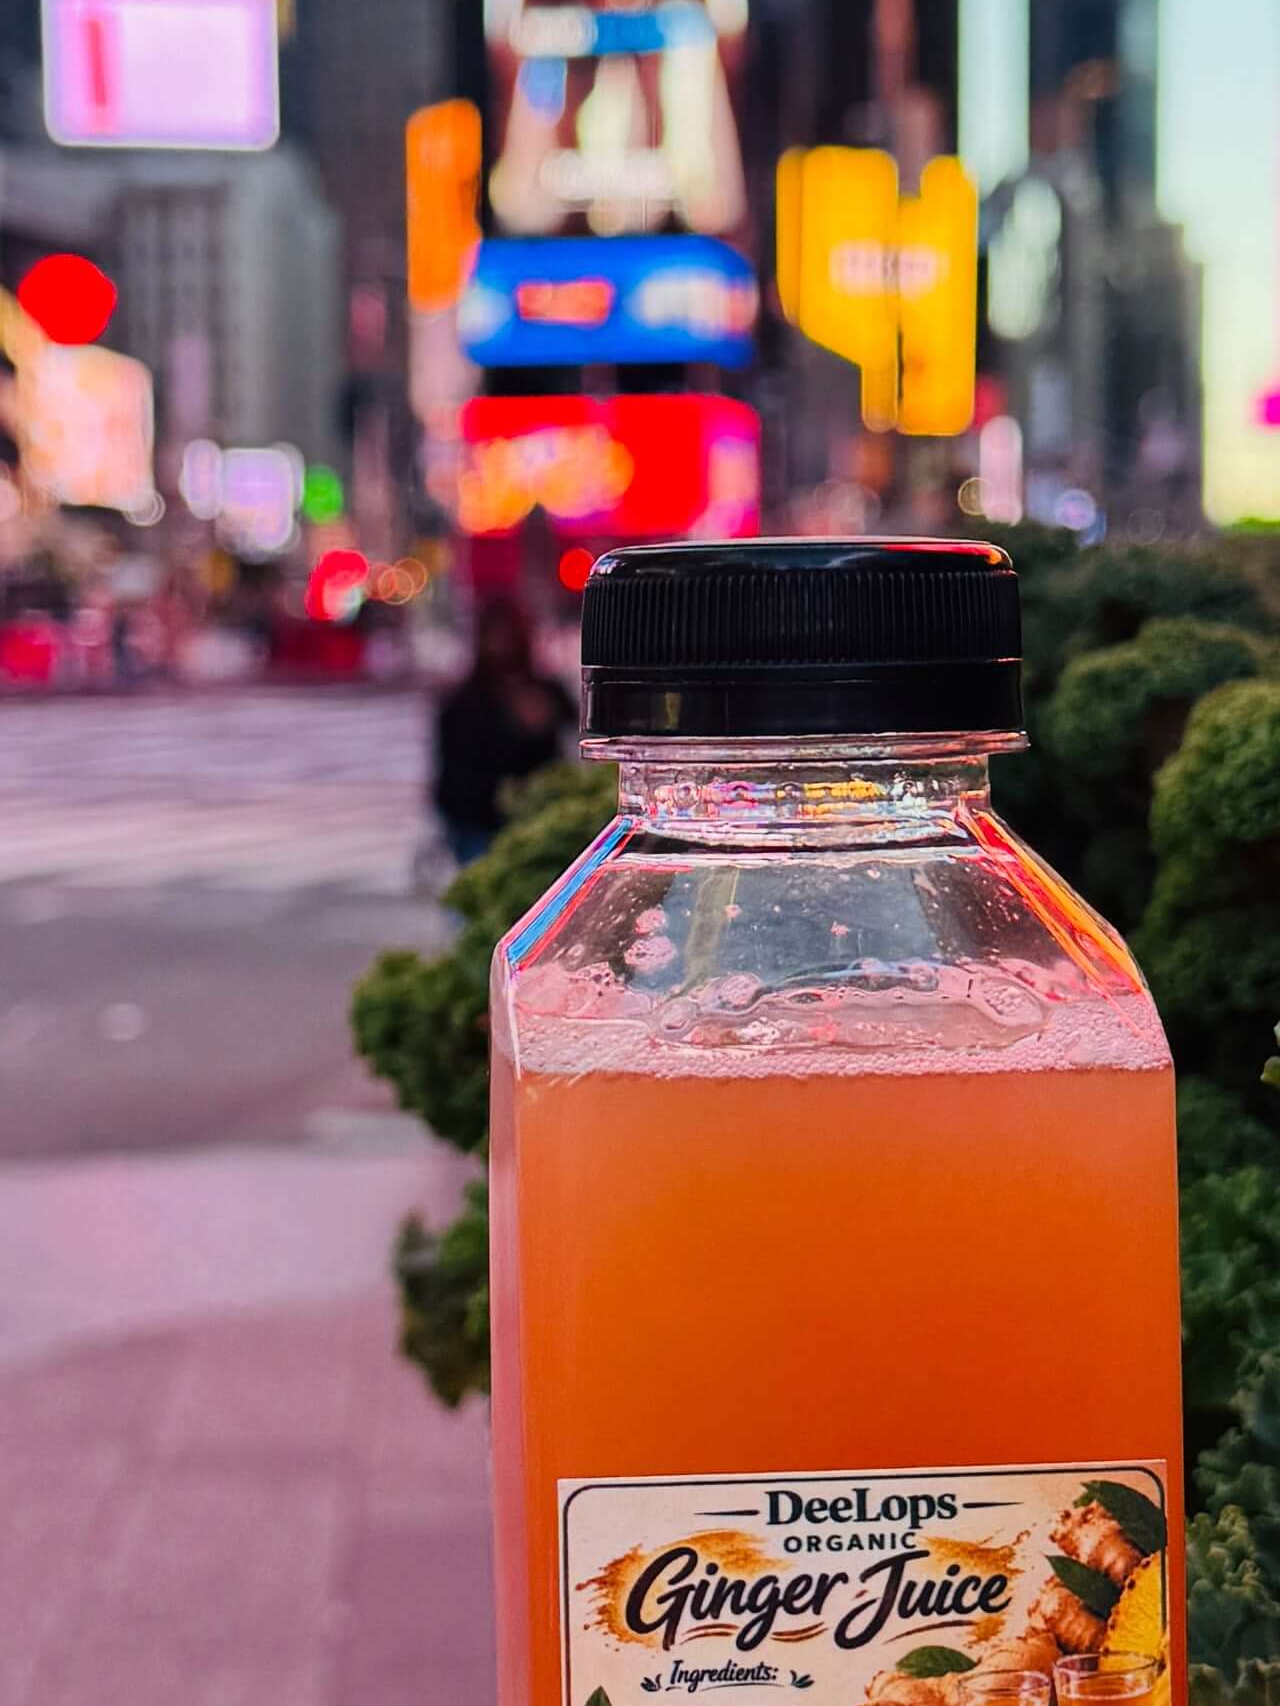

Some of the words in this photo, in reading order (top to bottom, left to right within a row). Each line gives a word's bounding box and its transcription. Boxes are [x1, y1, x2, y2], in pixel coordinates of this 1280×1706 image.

[765, 1487, 959, 1530] DeeLops
[783, 1531, 918, 1554] ORGANIC
[625, 1546, 849, 1652] Ginger
[834, 1549, 1013, 1650] Juice
[669, 1658, 780, 1693] Ingredients:
